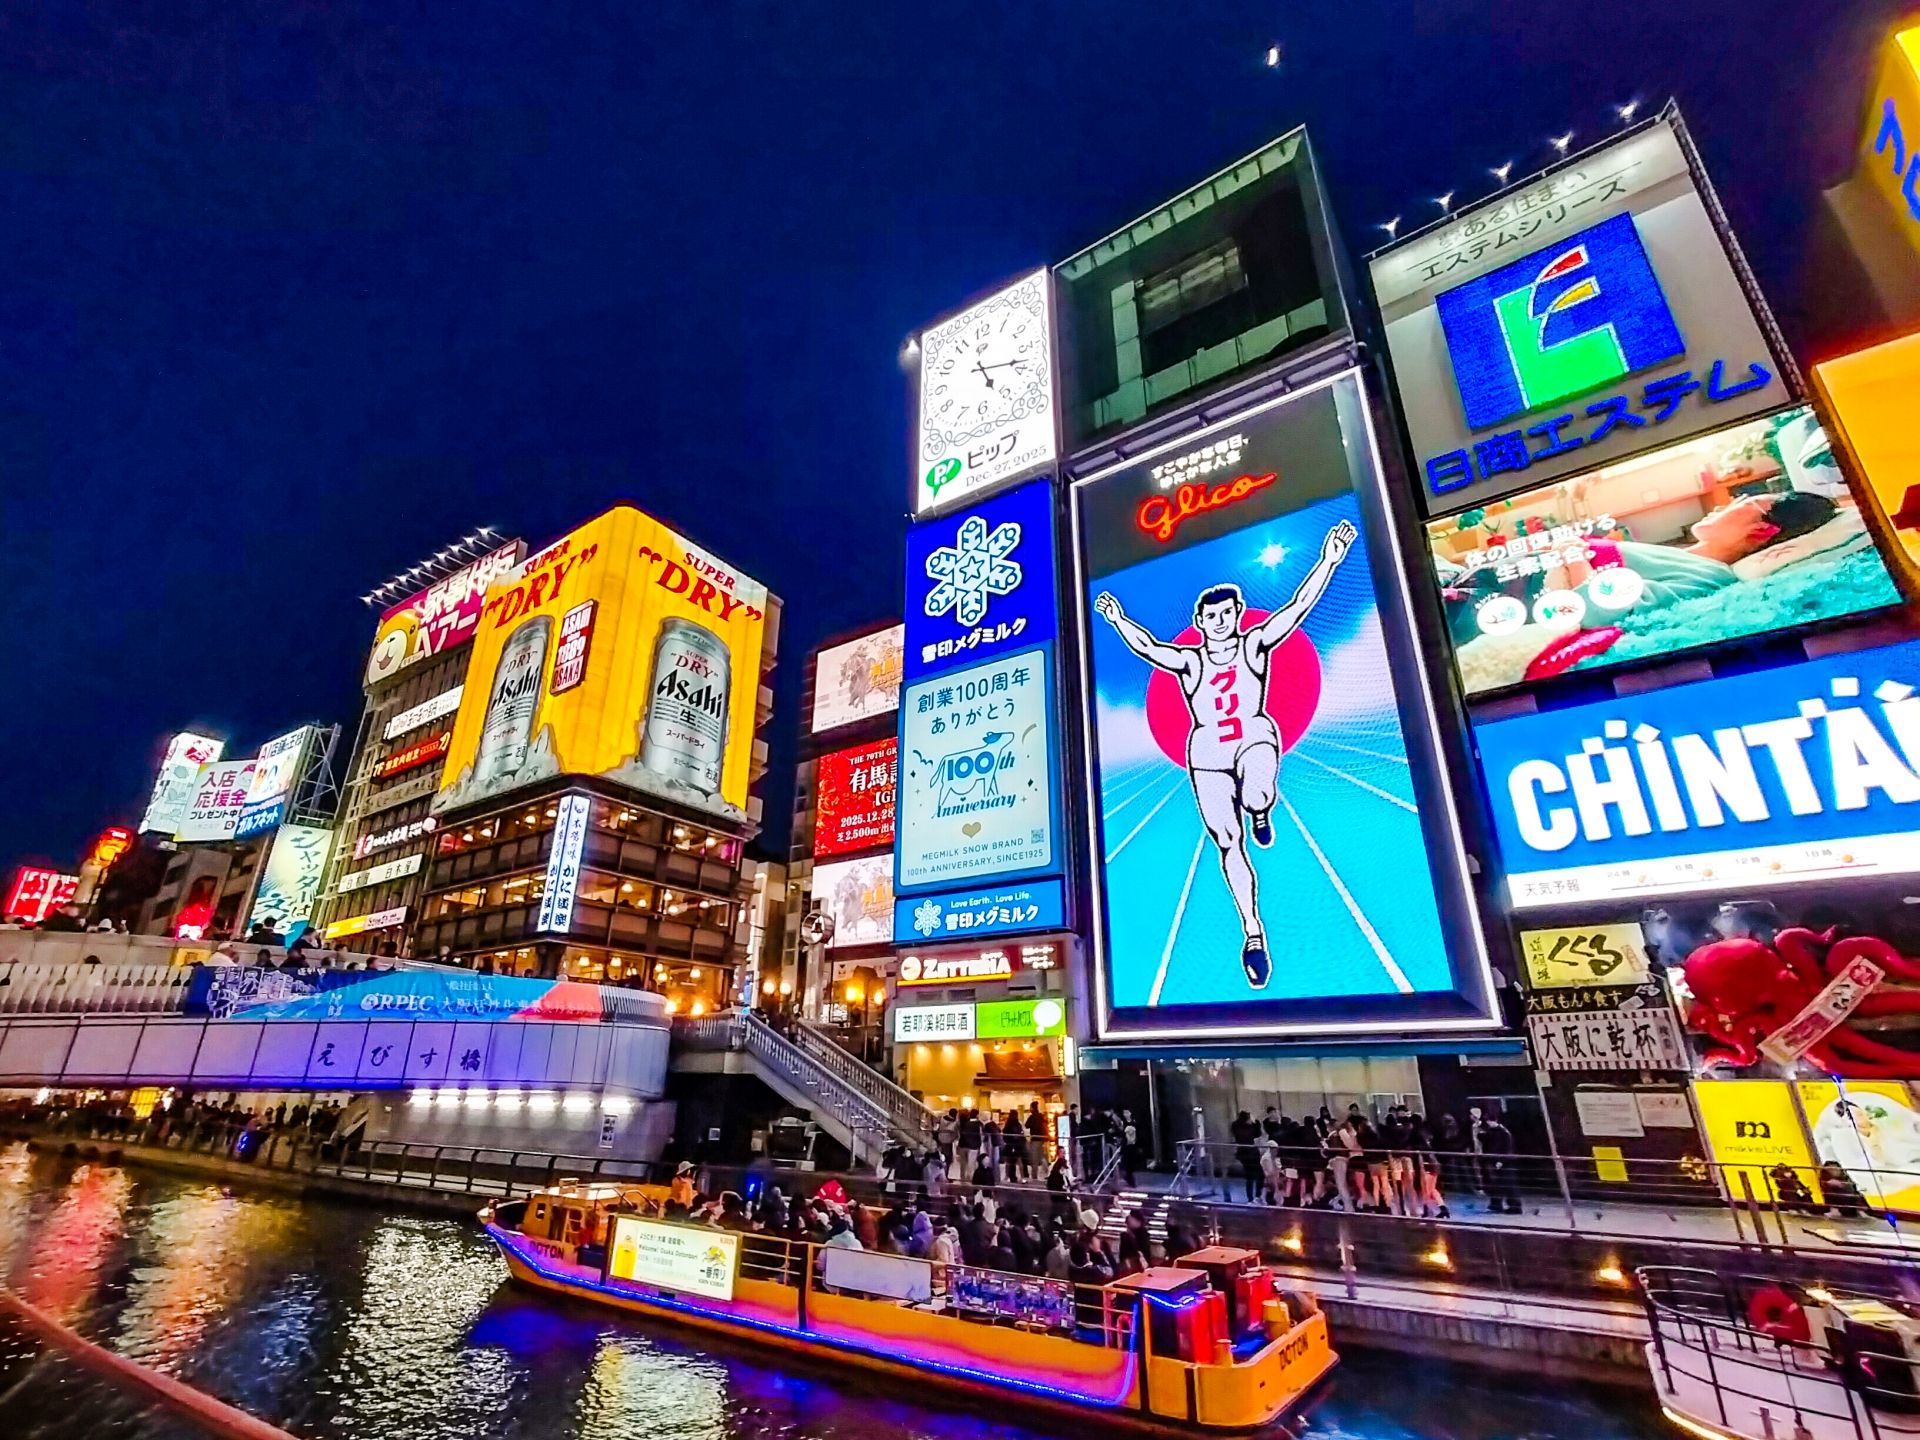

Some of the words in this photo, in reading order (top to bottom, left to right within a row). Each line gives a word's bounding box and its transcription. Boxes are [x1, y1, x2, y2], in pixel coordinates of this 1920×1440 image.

[1422, 178, 1626, 281] エステムシリーズ
[975, 324, 991, 341] 12
[999, 318, 1009, 333] 1
[1012, 324, 1026, 339] 2
[954, 340, 970, 355] 11
[1018, 341, 1034, 354] 3
[940, 359, 955, 377] 10
[1014, 363, 1029, 376] 4
[935, 385, 948, 396] 9
[999, 386, 1011, 399] 5
[940, 399, 954, 413] 8
[958, 406, 970, 419] 7
[978, 400, 988, 415] 6
[1426, 359, 1773, 497] 日商エステム
[967, 430, 1020, 469] ピップ
[966, 471, 990, 487] Dec.
[992, 460, 1012, 481] 27,
[1014, 445, 1047, 470] 2025
[1465, 512, 1616, 568] 体の回復助ける
[521, 539, 570, 579] SUPER
[683, 553, 736, 590] SUPER
[561, 607, 592, 639] ASAHI
[556, 637, 587, 666] 1889
[921, 617, 1027, 664] 雪印メグミルク
[491, 664, 541, 712] Asahi
[552, 660, 581, 690] OSAKA
[657, 669, 723, 720] Asahi
[917, 667, 1031, 713] 創業100周年
[504, 706, 516, 720] 生
[931, 698, 1016, 735] ありがとう
[1209, 665, 1243, 742] グリコ
[680, 708, 697, 727] 生
[665, 729, 706, 750] スーパードライ
[849, 755, 865, 766] THE
[866, 750, 885, 761] 70TH
[200, 770, 237, 789] 入店
[194, 788, 248, 809] 応援金
[931, 793, 1016, 819] Anniversary
[922, 848, 960, 861] MEGMILK
[962, 843, 989, 855] SNOW
[992, 838, 1024, 850] BRAND
[907, 867, 928, 877] 100th
[930, 857, 996, 873] ANNIVERSARY,
[996, 849, 1044, 864] SINCE1925
[951, 900, 968, 909] Love
[969, 898, 993, 908] Earth.
[995, 893, 1014, 904] Love
[1014, 890, 1033, 902] Life.
[1524, 878, 1581, 897] 天気予報
[945, 904, 1039, 931] 雪印メグミルク
[1548, 933, 1624, 977] くくる
[1541, 1020, 1657, 1060] 大阪に乾杯
[316, 1043, 481, 1072] えびす橋
